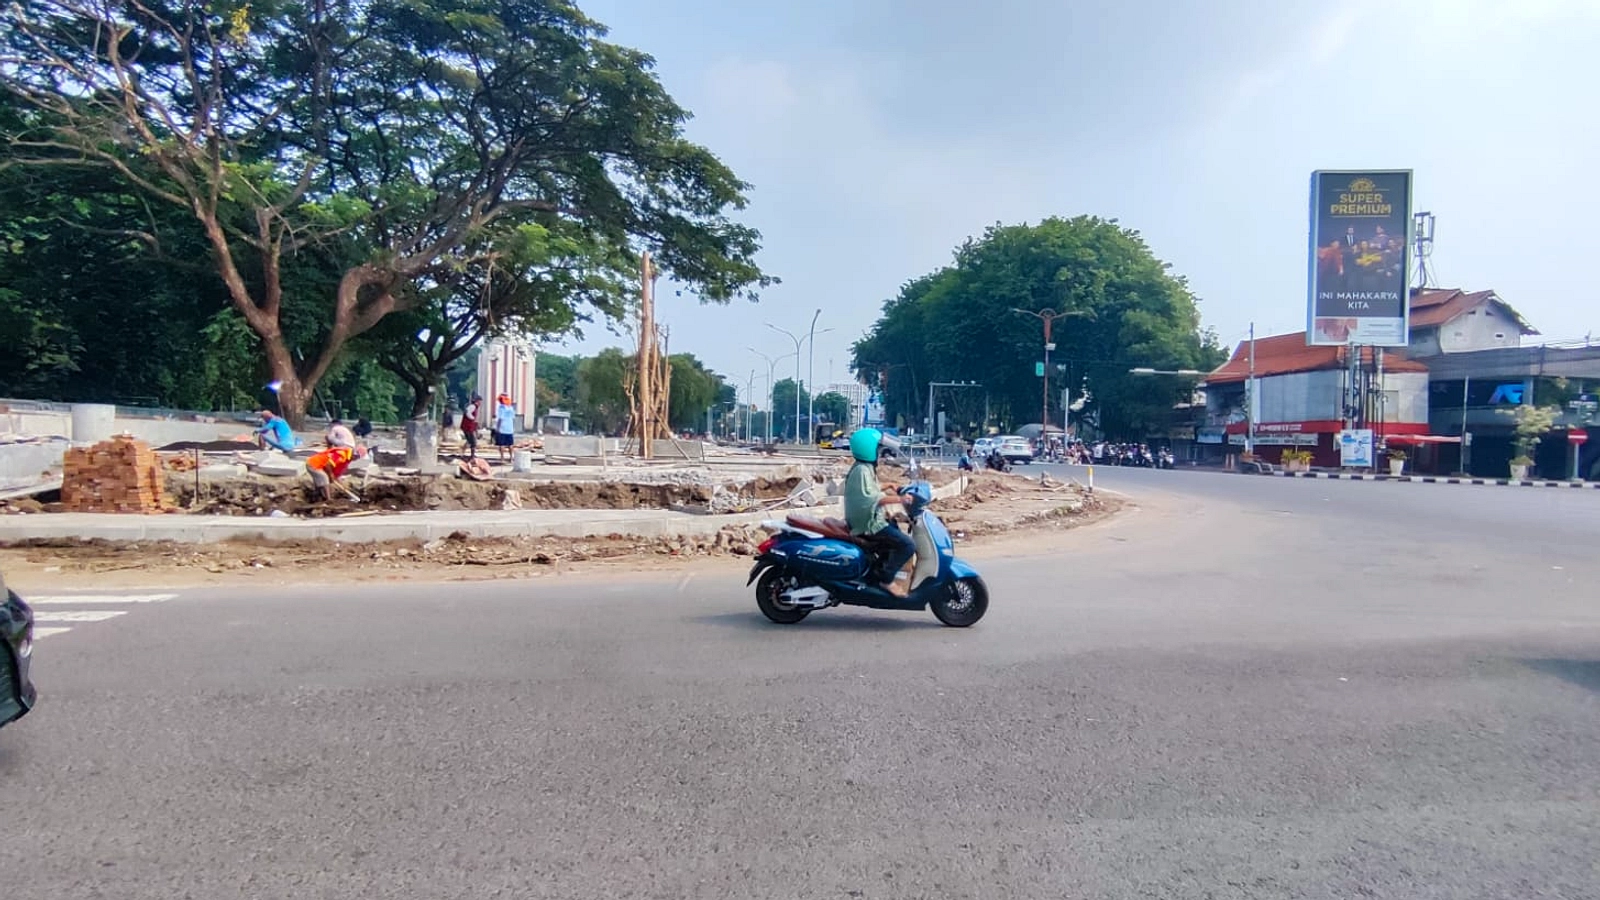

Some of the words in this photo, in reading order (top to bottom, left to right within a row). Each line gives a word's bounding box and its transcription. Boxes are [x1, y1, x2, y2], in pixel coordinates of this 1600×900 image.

[1340, 194, 1383, 203] SUPER
[1330, 204, 1391, 214] PREMIUM
[1337, 292, 1398, 300] MAHAKARYA
[1348, 301, 1369, 309] KITA
